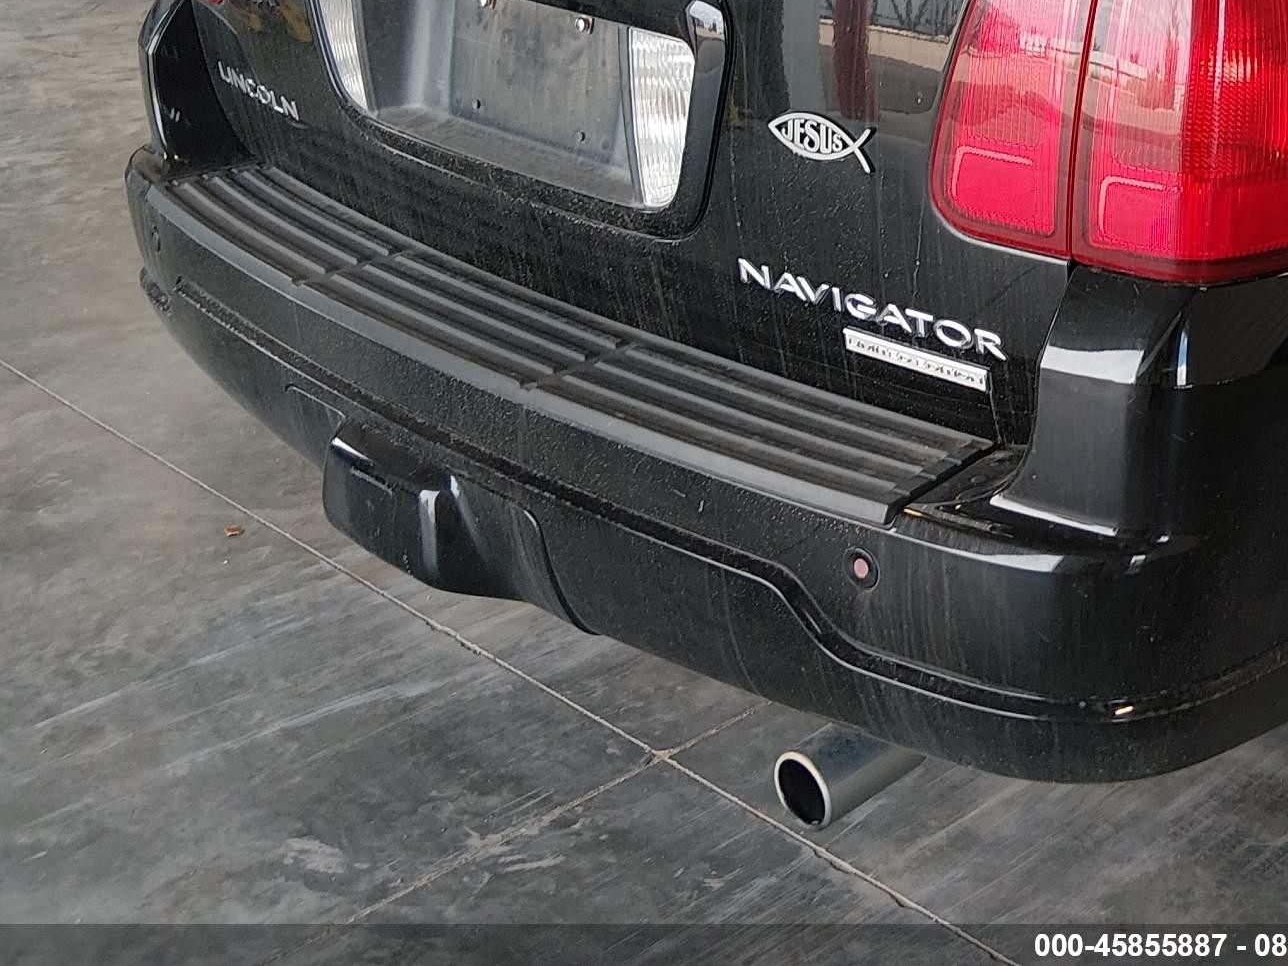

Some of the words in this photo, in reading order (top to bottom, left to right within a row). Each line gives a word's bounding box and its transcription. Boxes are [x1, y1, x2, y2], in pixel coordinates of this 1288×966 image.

[218, 60, 300, 122] LINCOLN
[781, 118, 844, 154] JESUS
[738, 257, 1009, 362] NAVIGATOR
